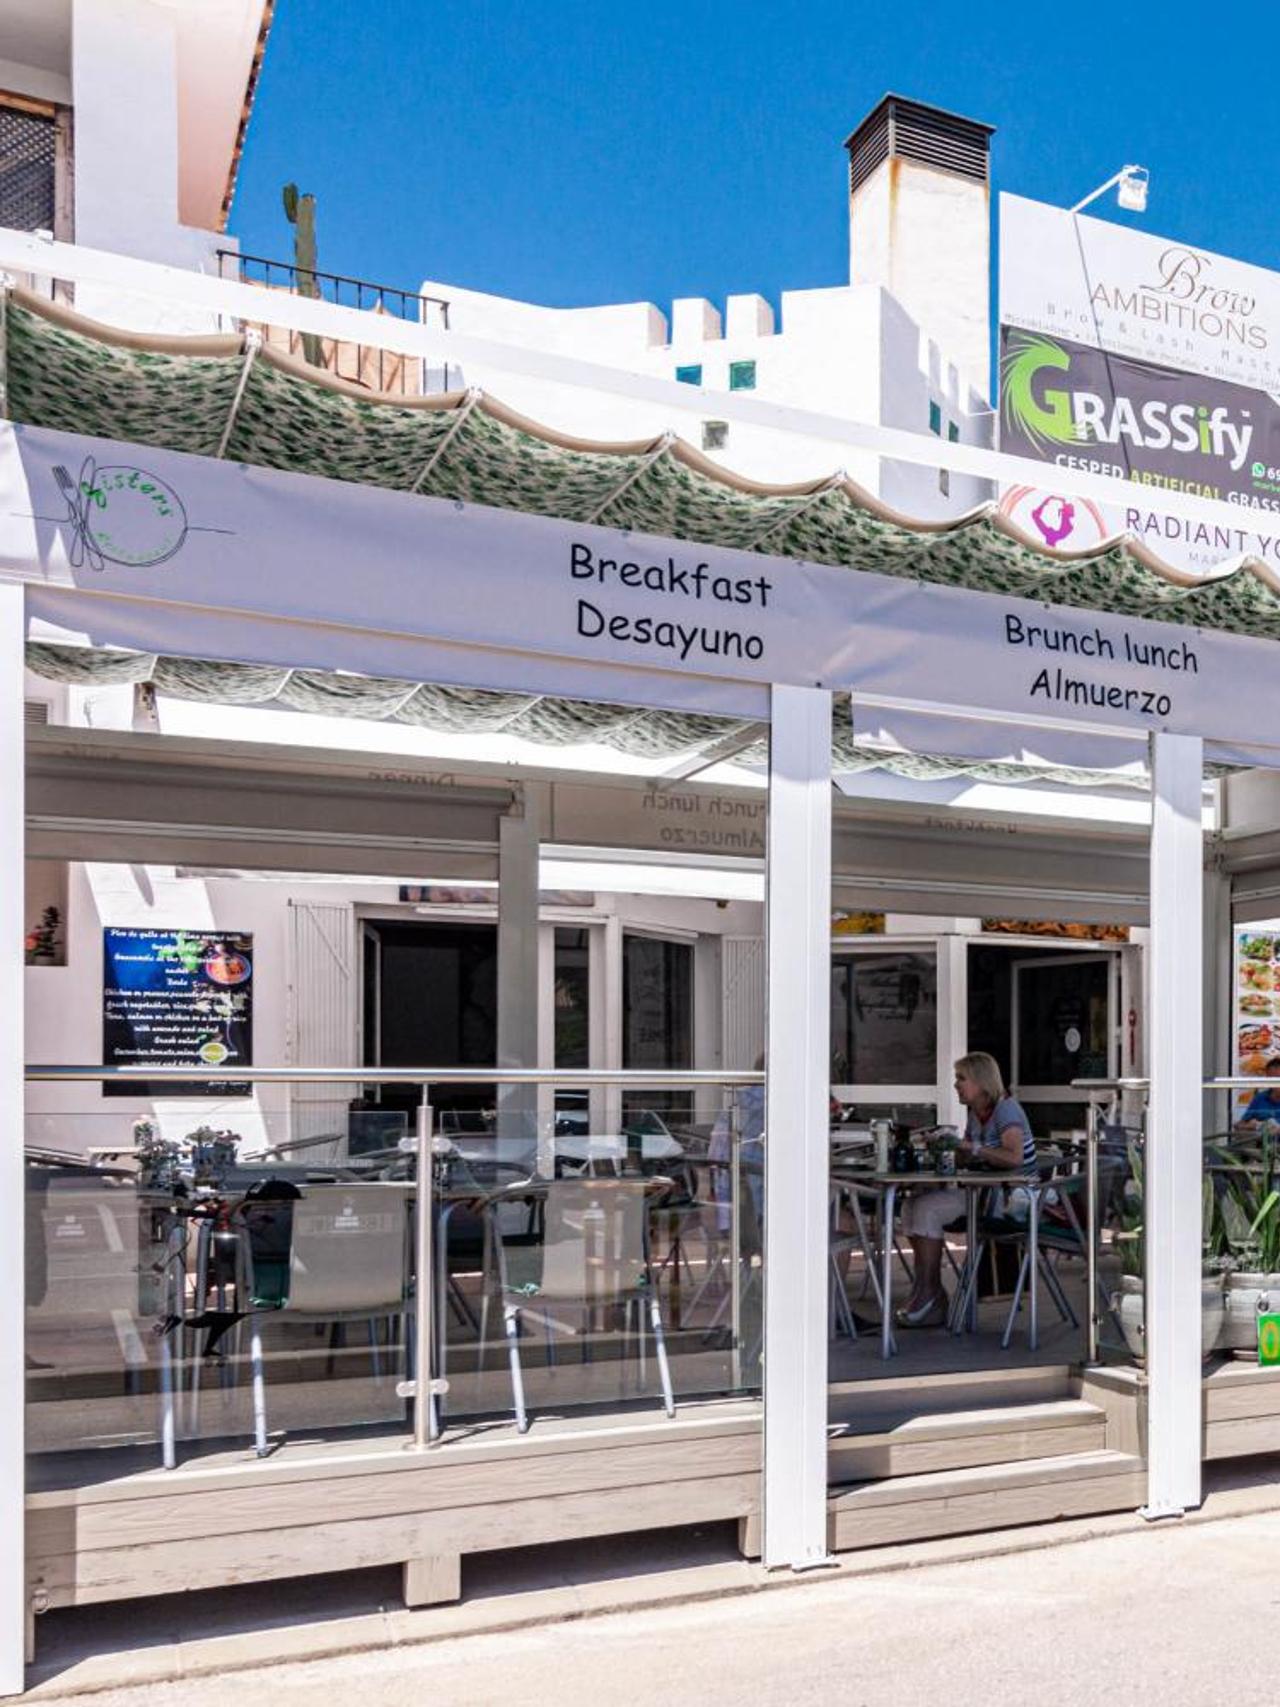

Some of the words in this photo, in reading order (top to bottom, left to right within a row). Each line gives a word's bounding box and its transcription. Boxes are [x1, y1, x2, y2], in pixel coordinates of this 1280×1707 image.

[1139, 247, 1256, 317] Brow
[1090, 283, 1268, 350] AMBITIONS
[1055, 453, 1125, 480] CESPED
[1228, 490, 1280, 512] GRASS
[1126, 508, 1248, 553] RADIANT
[570, 542, 773, 608] Breakfast
[576, 598, 765, 661] Desayuno
[1005, 614, 1115, 660] Brunch
[1124, 632, 1198, 674] lunch
[1029, 668, 1172, 716] Almuerzo
